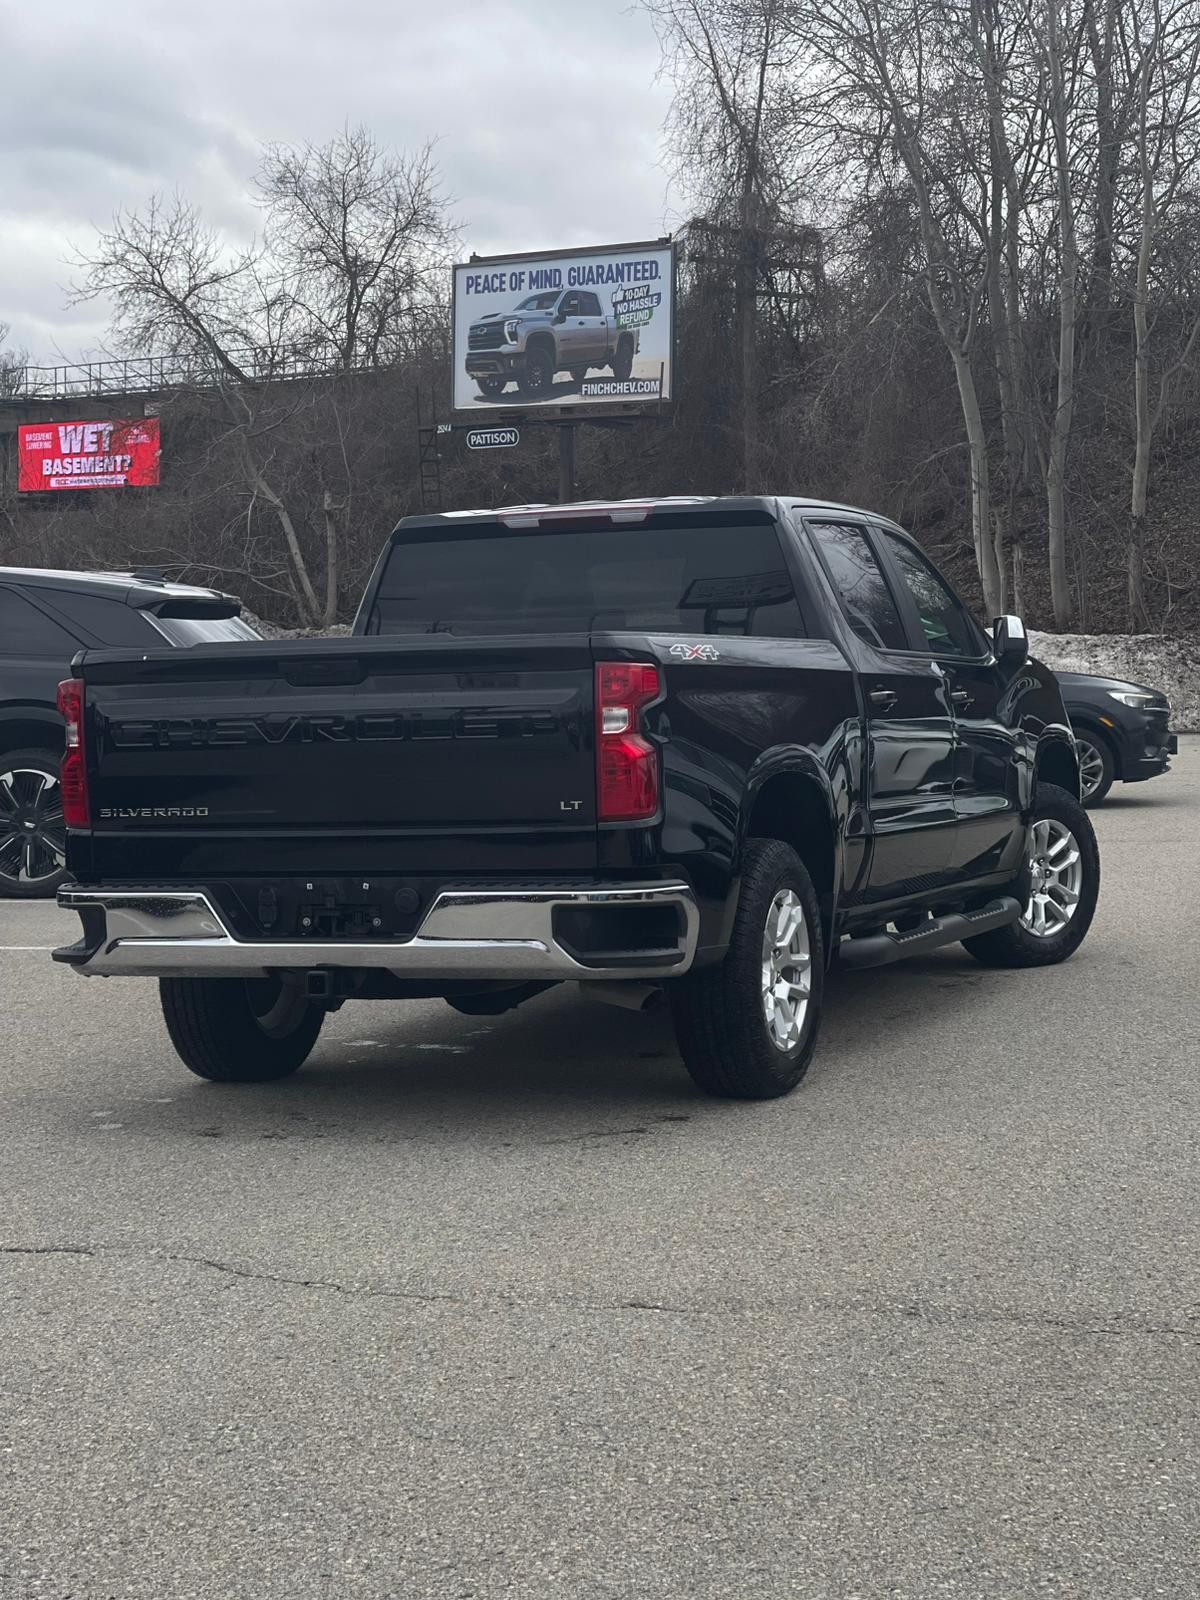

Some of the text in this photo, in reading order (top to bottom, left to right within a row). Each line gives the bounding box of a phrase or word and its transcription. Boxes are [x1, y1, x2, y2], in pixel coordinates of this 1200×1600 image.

[466, 273, 506, 294] PEACE
[509, 271, 525, 292] OF
[568, 260, 661, 286] GUARANTEED.
[617, 295, 658, 314] NO HASSLE
[620, 309, 649, 325] REFUND
[582, 380, 660, 395] FINCHCHEV.COM
[25, 432, 52, 442] BASEMENT
[58, 423, 113, 454] WET
[470, 431, 515, 445] PATTISON
[42, 455, 131, 475] BASEMENT?
[111, 710, 557, 747] CHEVROLET
[99, 807, 209, 818] SILVERADO
[560, 800, 583, 811] LT
